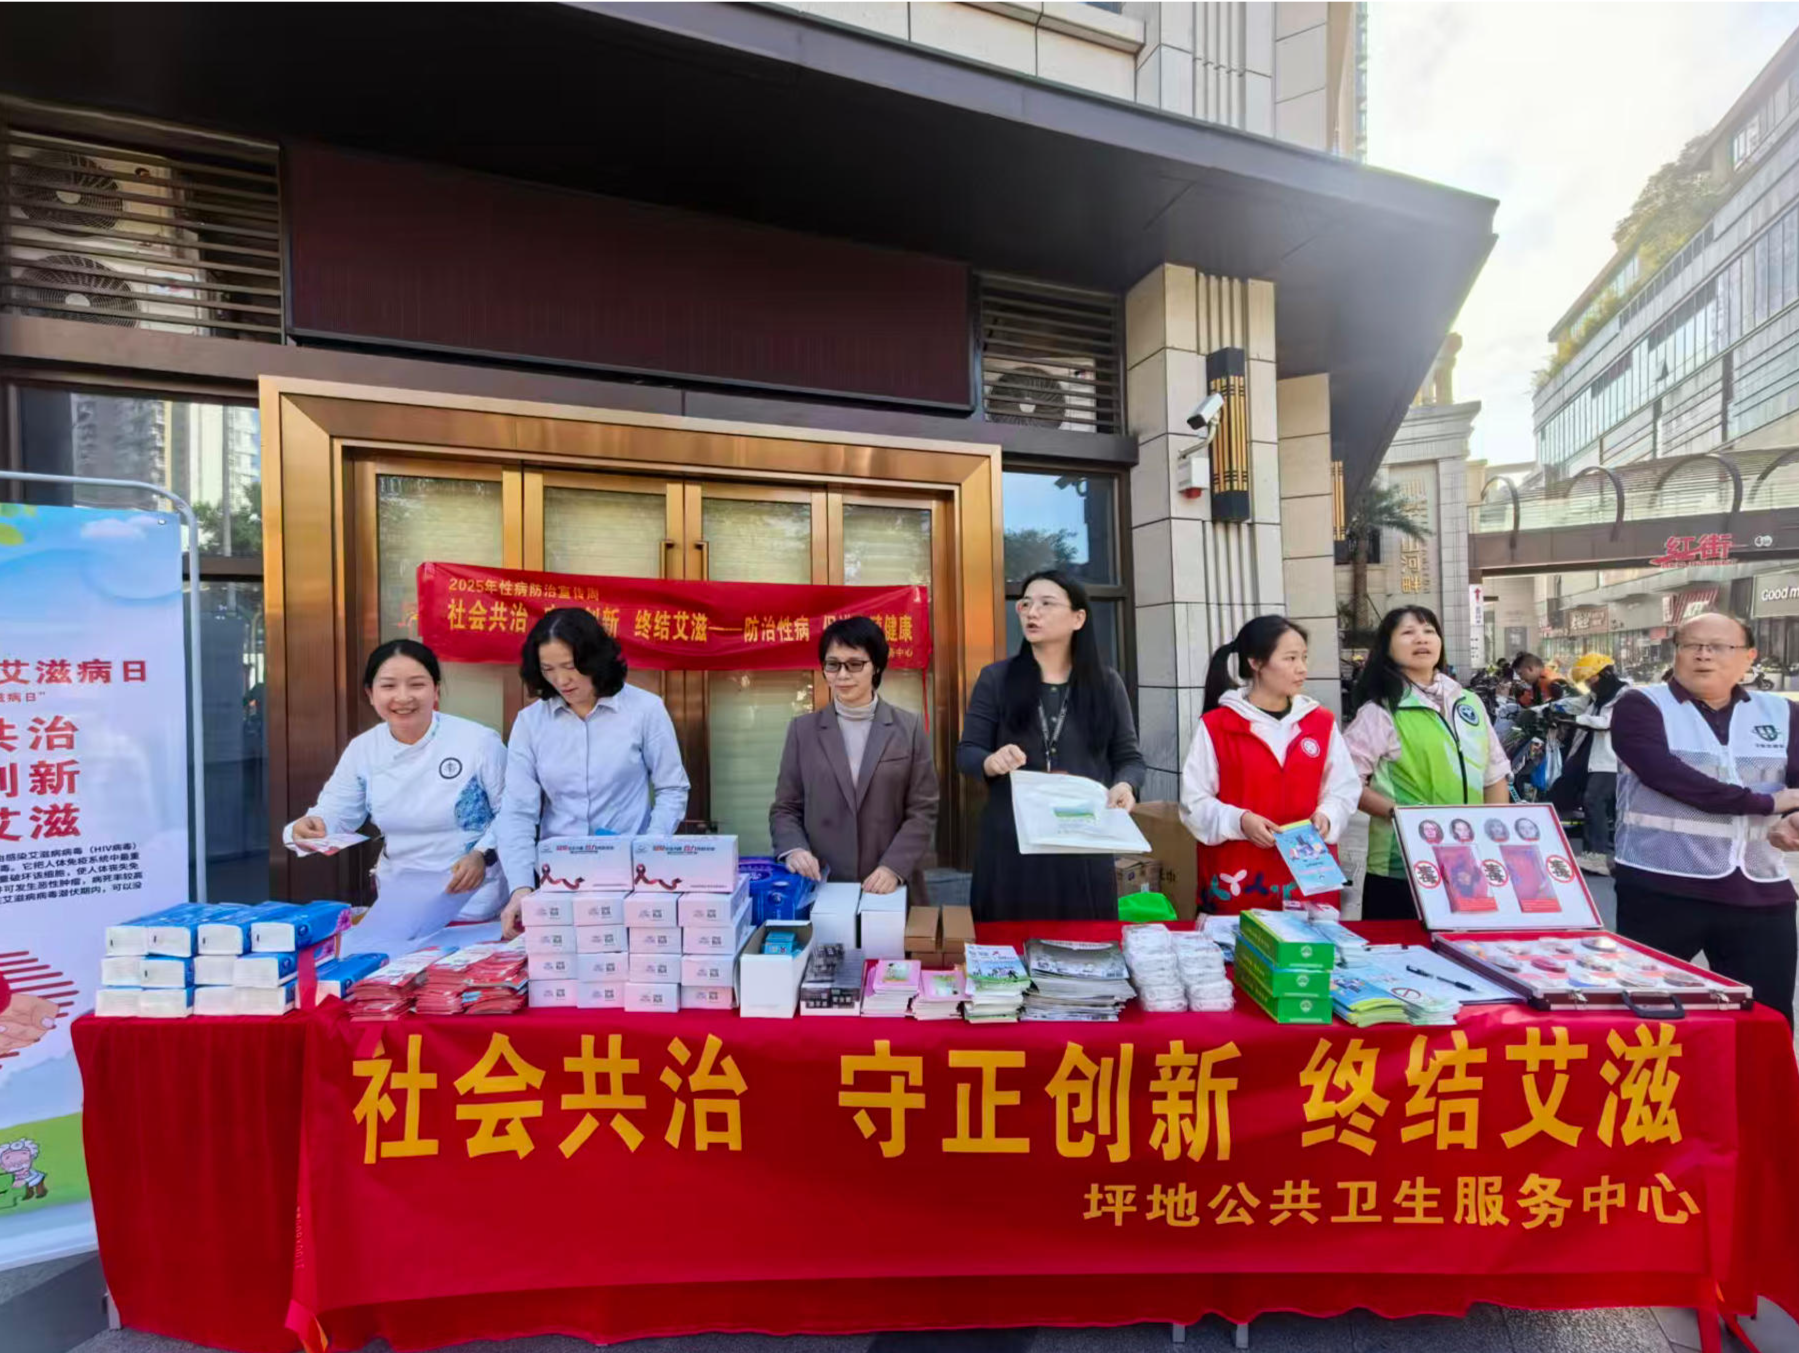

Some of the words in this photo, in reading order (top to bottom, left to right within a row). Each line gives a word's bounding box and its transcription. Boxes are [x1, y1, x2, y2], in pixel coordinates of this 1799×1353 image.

[1657, 533, 1734, 562] 红街
[448, 576, 599, 602] 2025年性病防治宣传周
[447, 598, 527, 632] 社会共治
[0, 659, 147, 685] 艾滋病日
[353, 1033, 748, 1164] 社会共治
[838, 1039, 1240, 1163] 守正创新
[1299, 1021, 1685, 1155] 终结艾滋
[1084, 1172, 1699, 1229] 坪地公共卫生服务中心
